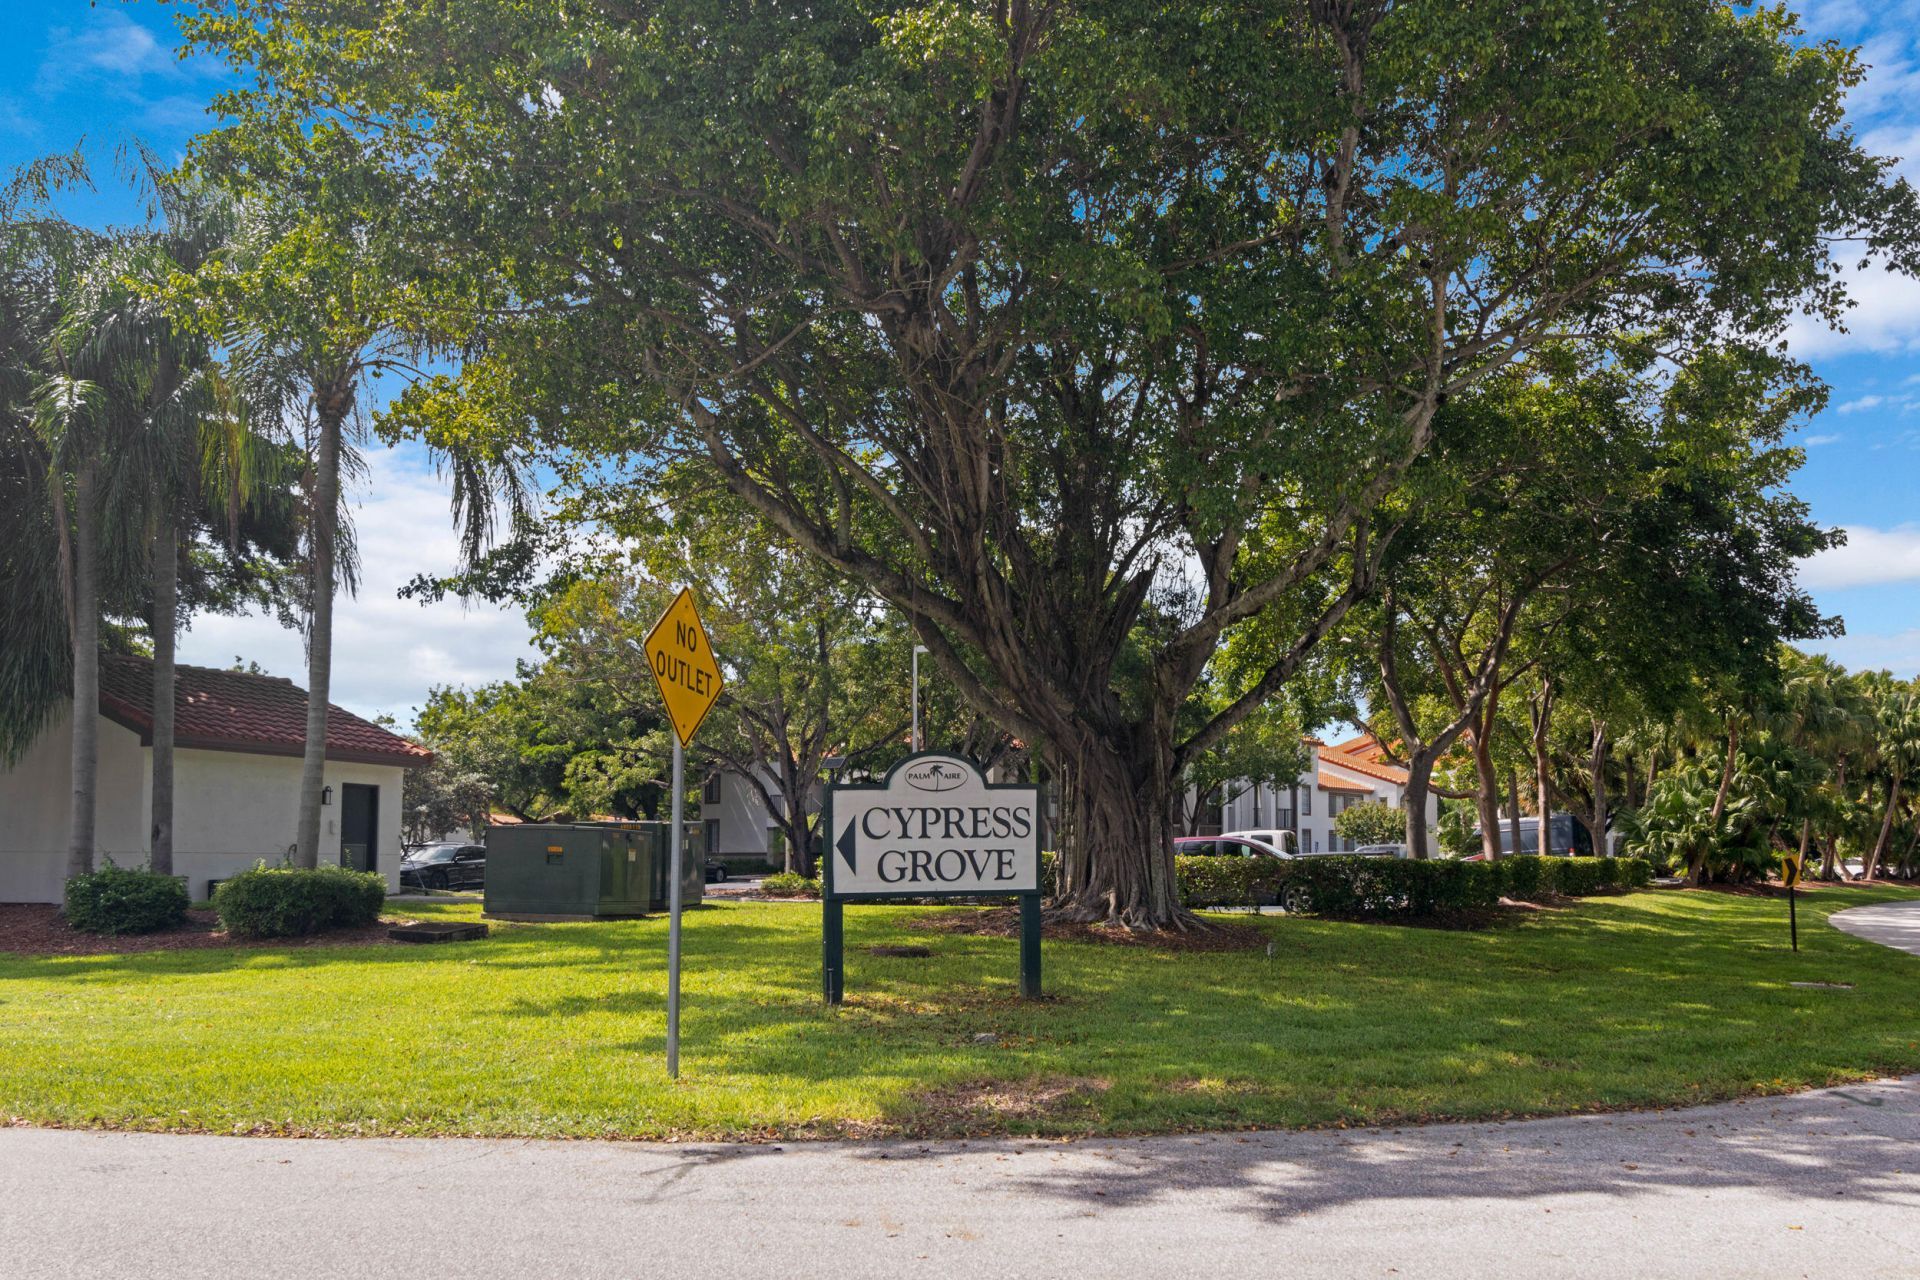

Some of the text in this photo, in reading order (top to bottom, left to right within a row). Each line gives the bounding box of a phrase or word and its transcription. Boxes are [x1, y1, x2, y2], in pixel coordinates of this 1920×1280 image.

[676, 619, 697, 653] NO
[656, 650, 712, 698] OUTLET
[908, 772, 961, 780] PALM AIRE
[862, 806, 1031, 840] CYPRESS
[877, 849, 1017, 883] GROVE
